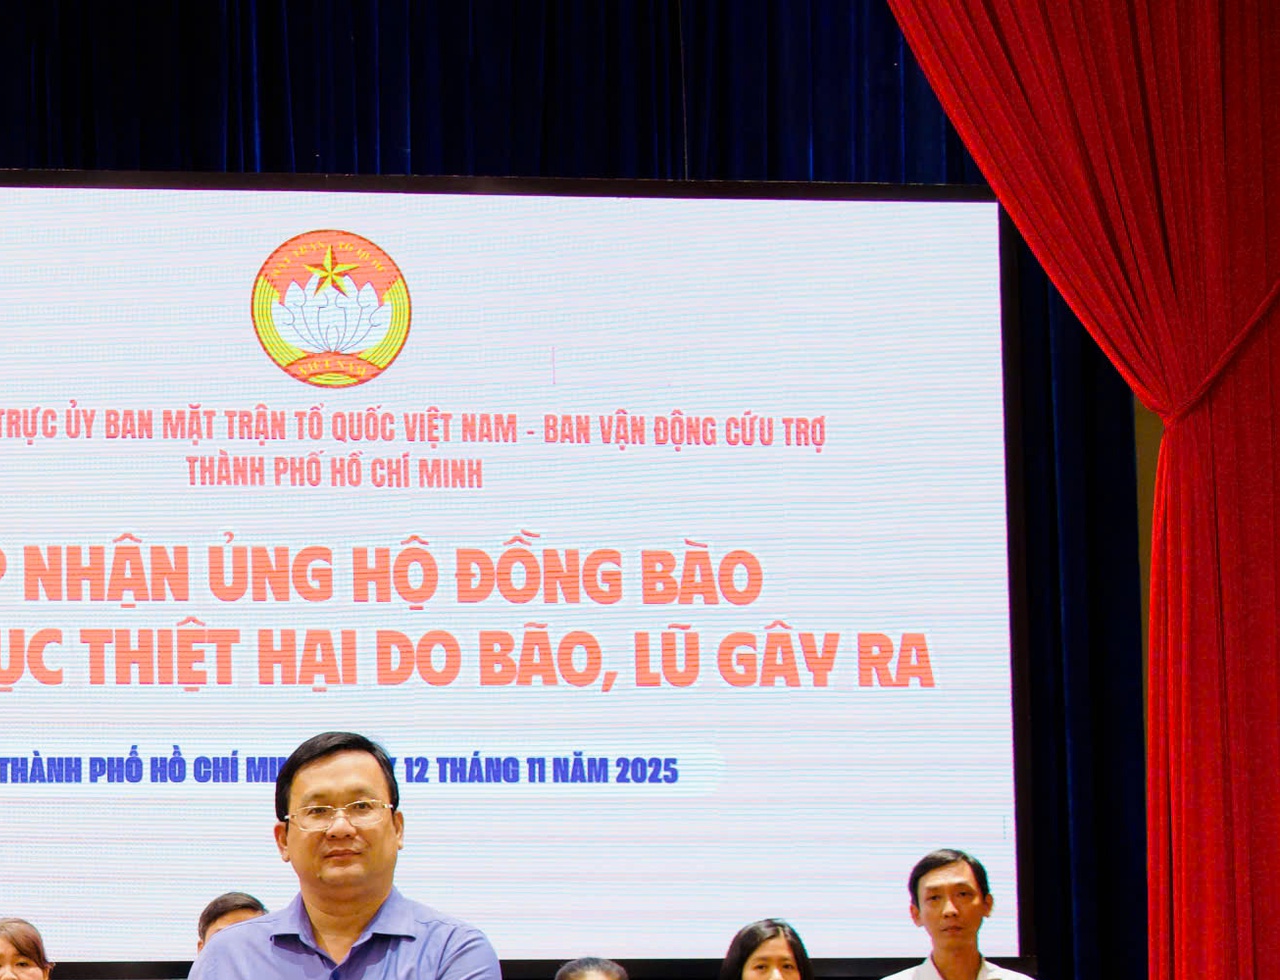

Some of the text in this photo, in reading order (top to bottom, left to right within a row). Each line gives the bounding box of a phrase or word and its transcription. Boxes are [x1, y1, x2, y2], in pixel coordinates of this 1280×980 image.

[65, 399, 96, 438] ỦY
[105, 409, 153, 439] BAN
[162, 403, 216, 446] MẶT
[224, 403, 286, 446] TRẬN
[295, 402, 325, 440] TỔ
[332, 405, 395, 443] QUỐC
[403, 406, 452, 448] VIỆT
[462, 413, 517, 443] NAM
[544, 414, 590, 444] BAN
[598, 408, 645, 451] VẬN
[654, 409, 716, 452] ĐỘNG
[726, 410, 774, 446] CỨU
[782, 415, 826, 453] TRỢ
[186, 449, 482, 488] THÀNH PHỐ HỒ CHÍ MINH
[24, 532, 189, 608] NHẬN
[209, 531, 333, 603] ỦNG
[352, 534, 439, 610] HỘ
[455, 529, 622, 605] ĐỒNG
[641, 538, 763, 606] BÀO
[80, 616, 240, 692] THIỆT
[258, 629, 357, 692] HẠI
[376, 629, 461, 687] DO
[479, 621, 618, 693] BÃO,
[634, 623, 700, 688] LŨ
[717, 620, 840, 688] GÂY
[857, 631, 936, 688] RA
[89, 744, 143, 783] PHỐ
[150, 744, 186, 783] HỒ
[193, 750, 239, 783] CHÍ
[246, 757, 288, 783] MI
[404, 756, 429, 783] 12
[437, 751, 520, 783] THÁNG
[527, 757, 547, 783] 11
[553, 751, 608, 783] NĂM
[615, 756, 679, 783] 2025
